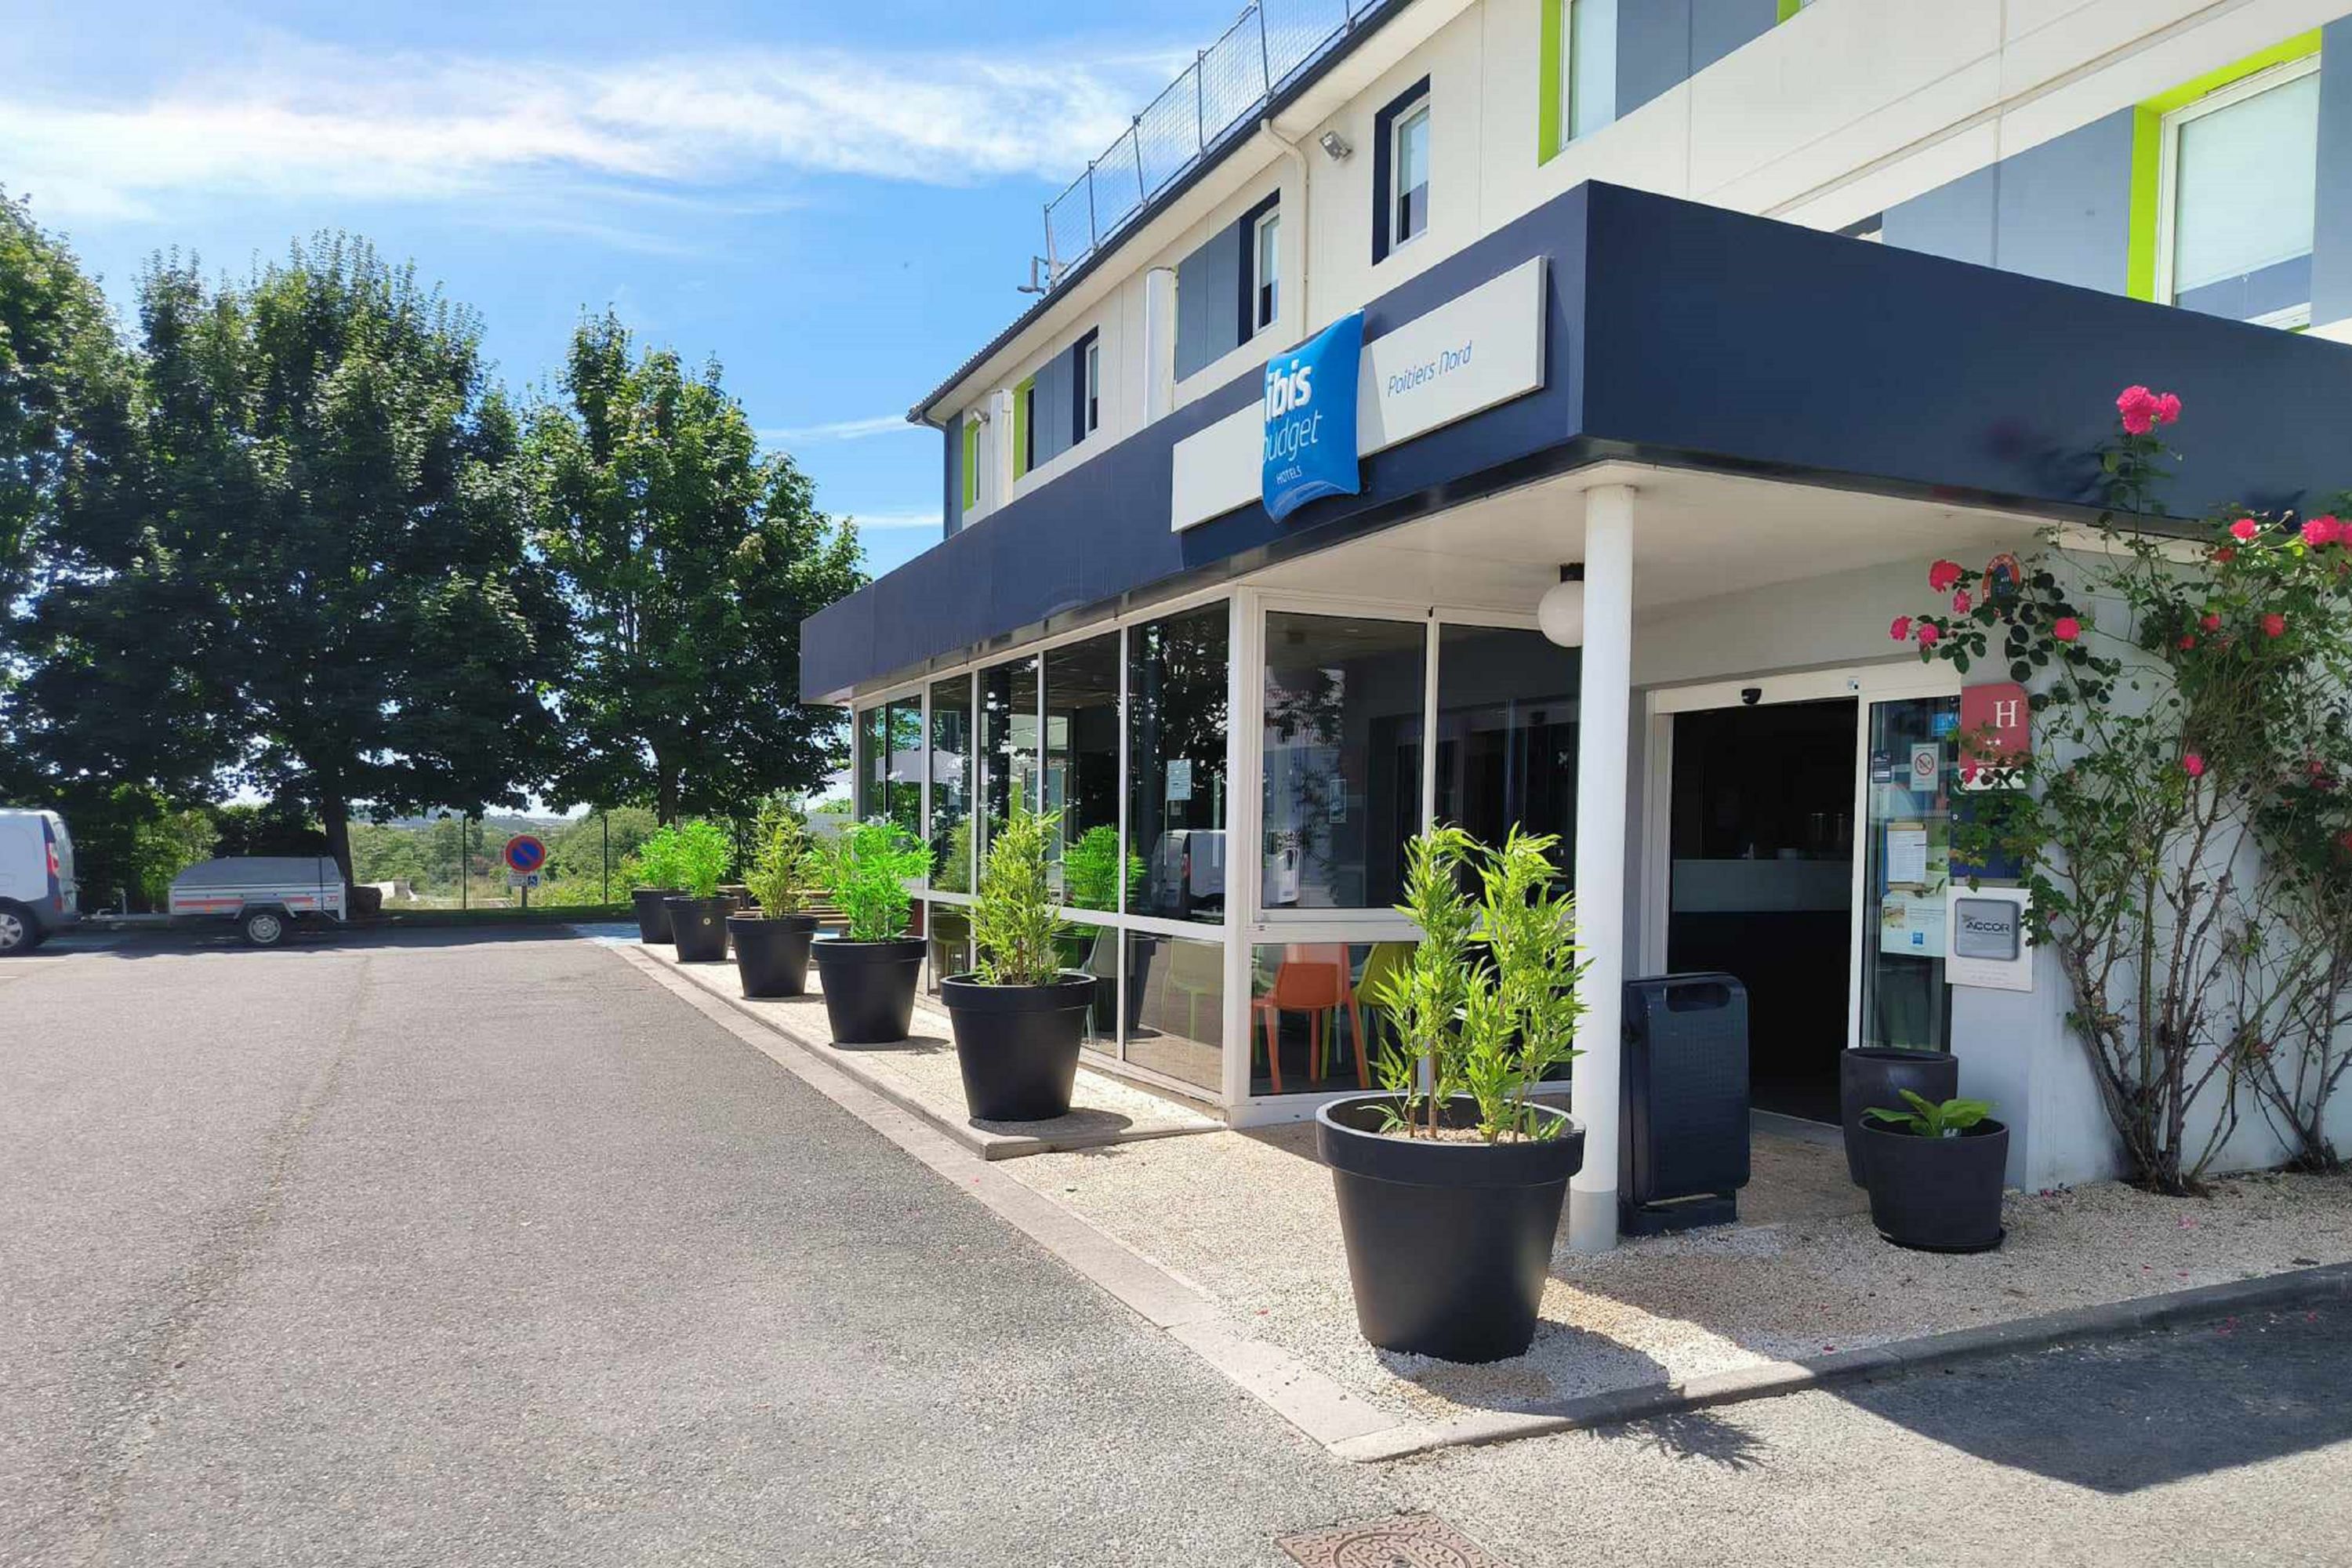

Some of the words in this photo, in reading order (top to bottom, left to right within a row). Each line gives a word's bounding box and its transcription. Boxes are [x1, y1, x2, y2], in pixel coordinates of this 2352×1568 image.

[1388, 362, 1436, 397] Poitiers
[1439, 339, 1472, 376] Nord
[1265, 358, 1312, 423] ibis
[1276, 465, 1301, 485] HOTELS
[1994, 699, 2020, 728] H
[1966, 921, 2010, 932] ACCOR
